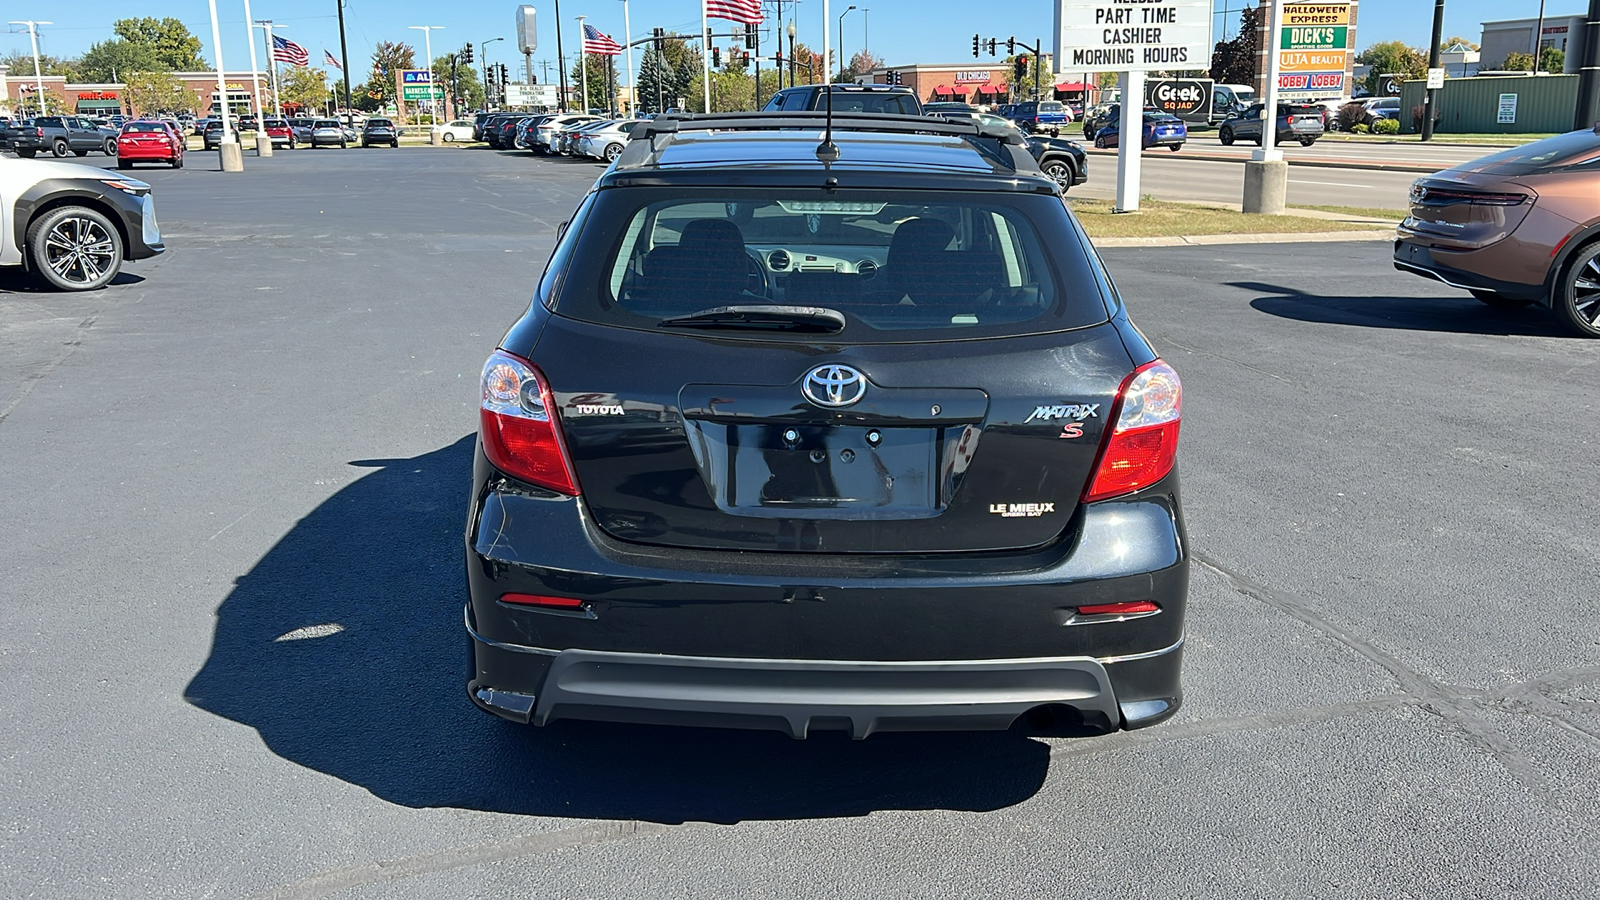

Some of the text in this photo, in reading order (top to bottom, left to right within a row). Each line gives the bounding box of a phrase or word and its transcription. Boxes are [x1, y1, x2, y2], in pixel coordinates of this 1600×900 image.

[1095, 7, 1176, 24] PART TIME
[1283, 6, 1347, 14] HALLOWEEN
[1290, 15, 1338, 23] EXPRESS
[1103, 27, 1162, 44] CASHIER
[1290, 27, 1334, 44] DICK'S
[1073, 46, 1188, 65] MORNING HOURS
[1280, 53, 1343, 66] ULTA BEAUTY
[956, 71, 990, 80] OLD CHICAGO
[1278, 73, 1342, 88] HOBBY LOBBY
[1158, 85, 1200, 101] Geek
[576, 404, 625, 416] TOYOTA
[1022, 403, 1100, 424] MATRIX
[1059, 422, 1085, 439] S
[989, 502, 1055, 513] LE MIEUX
